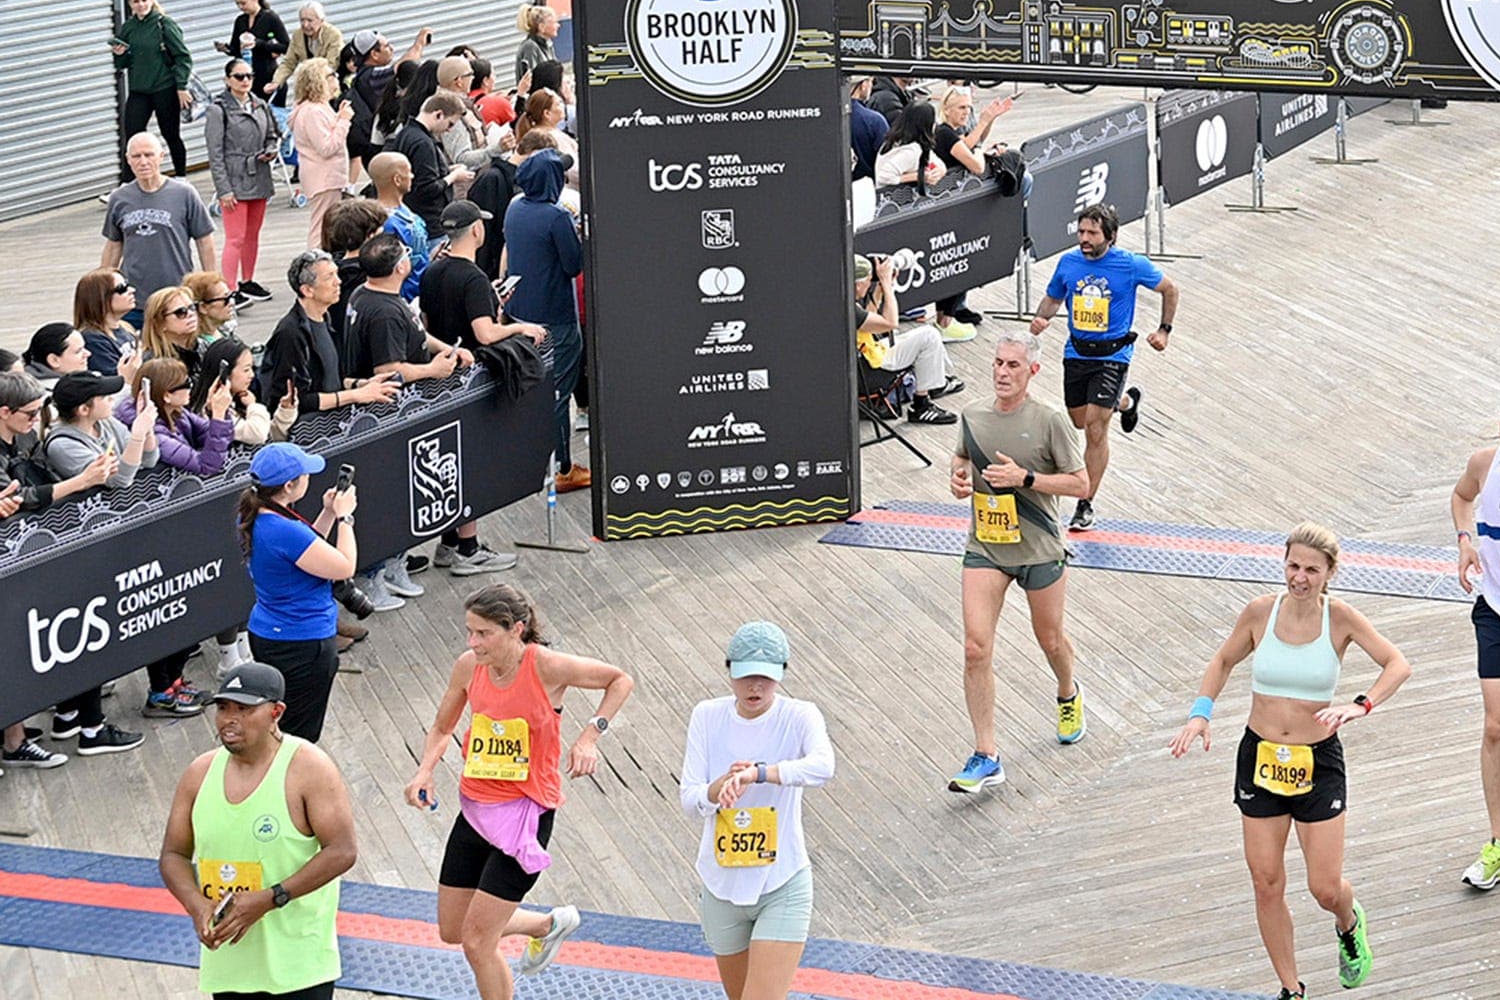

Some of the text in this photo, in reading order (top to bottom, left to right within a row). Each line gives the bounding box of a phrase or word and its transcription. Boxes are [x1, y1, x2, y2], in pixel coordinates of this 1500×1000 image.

[647, 8, 777, 39] BROOKLYN
[682, 37, 744, 66] HALF
[1281, 94, 1313, 116] UNITED
[666, 114, 693, 125] NEW
[698, 112, 729, 124] YORK
[731, 110, 764, 122] ROAD
[767, 107, 821, 120] RUNNERS
[1274, 105, 1314, 137] AIRLINES
[707, 154, 741, 165] TATA
[707, 162, 786, 177] CONSULTANCY
[648, 157, 703, 192] tcs
[708, 176, 759, 189] SERVICES
[706, 235, 731, 245] RBC
[928, 231, 958, 251] TATA
[928, 235, 992, 266] CONSULTANCY
[929, 258, 970, 283] SERVICES
[700, 294, 744, 304] mastercard
[695, 343, 753, 355] new balance
[678, 381, 745, 395] AIRLINES
[691, 372, 745, 385] UNITED
[416, 495, 458, 528] RBC
[115, 559, 164, 593] TATA
[116, 557, 224, 617] CONSULTANCY
[118, 601, 188, 642] SERVICES
[27, 595, 111, 674] tcs
[472, 737, 522, 756] D 11184
[1259, 763, 1307, 784] C 18199
[717, 831, 766, 853] C 5572
[203, 883, 214, 900] C
